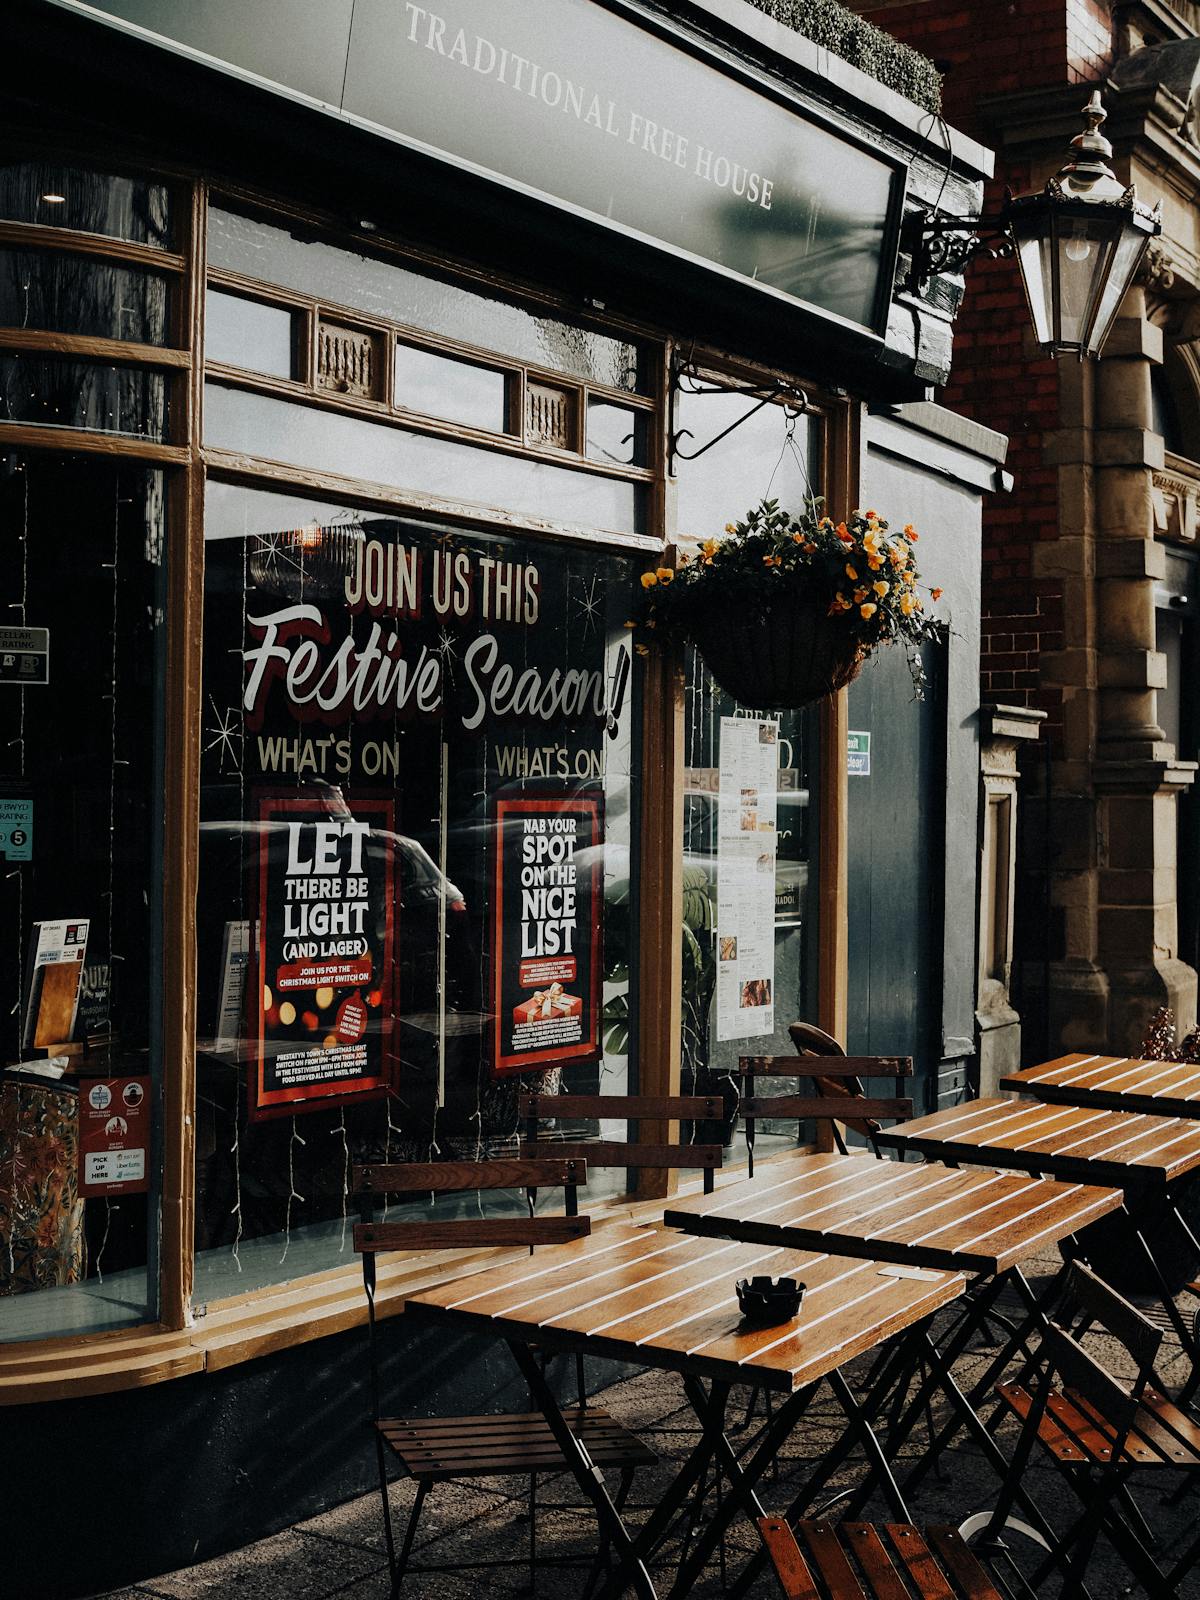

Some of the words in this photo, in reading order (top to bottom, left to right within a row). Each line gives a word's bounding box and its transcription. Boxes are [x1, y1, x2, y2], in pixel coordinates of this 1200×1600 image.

[405, 2, 619, 137] TRADITIONAL
[627, 112, 689, 170] FREE
[694, 145, 774, 211] HOUSE
[344, 539, 418, 610] JOIN
[433, 550, 471, 617] US
[479, 559, 539, 625] THIS
[3, 641, 34, 649] RATING
[241, 603, 442, 713] Festive
[257, 733, 352, 776] WHAT'S
[361, 740, 400, 776] ON
[494, 742, 570, 780] WHAT'S
[574, 747, 605, 779] ON
[523, 818, 546, 834] NAB
[548, 818, 577, 834] YOUR
[285, 822, 370, 875] LET
[522, 835, 577, 864] SPOT
[284, 878, 342, 900] THERE
[346, 877, 369, 898] BE
[521, 865, 545, 888] ON
[548, 865, 577, 886] THE
[521, 887, 577, 921] NICE
[283, 901, 370, 938] LIGHT
[283, 941, 318, 962] (AND
[320, 937, 369, 958] LAGER)
[520, 919, 577, 958] LIST
[280, 977, 317, 987] CHRISTMAS
[317, 975, 334, 984] LIGHT
[335, 974, 358, 983] SWITCH
[358, 973, 369, 981] ON
[300, 968, 316, 977] JOIN
[316, 967, 326, 975] US
[326, 966, 338, 974] FOR
[338, 965, 351, 973] THE
[275, 1060, 294, 1069] SWITCH
[295, 1059, 304, 1067] ON
[304, 1057, 318, 1066] FROM
[342, 1052, 354, 1061] THEN
[355, 1051, 367, 1059] JOIN
[325, 1046, 352, 1055] CHRISTMAS
[352, 1044, 367, 1052] LIGHT
[275, 1069, 281, 1077] IN
[282, 1068, 291, 1076] THE
[320, 1062, 333, 1071] WITH
[333, 1061, 340, 1069] US
[340, 1059, 354, 1068] FROM
[282, 1075, 295, 1084] FOOD
[295, 1072, 315, 1082] SERVED
[315, 1071, 324, 1079] ALL
[324, 1070, 333, 1078] DAY
[334, 1068, 349, 1077] UNTIL
